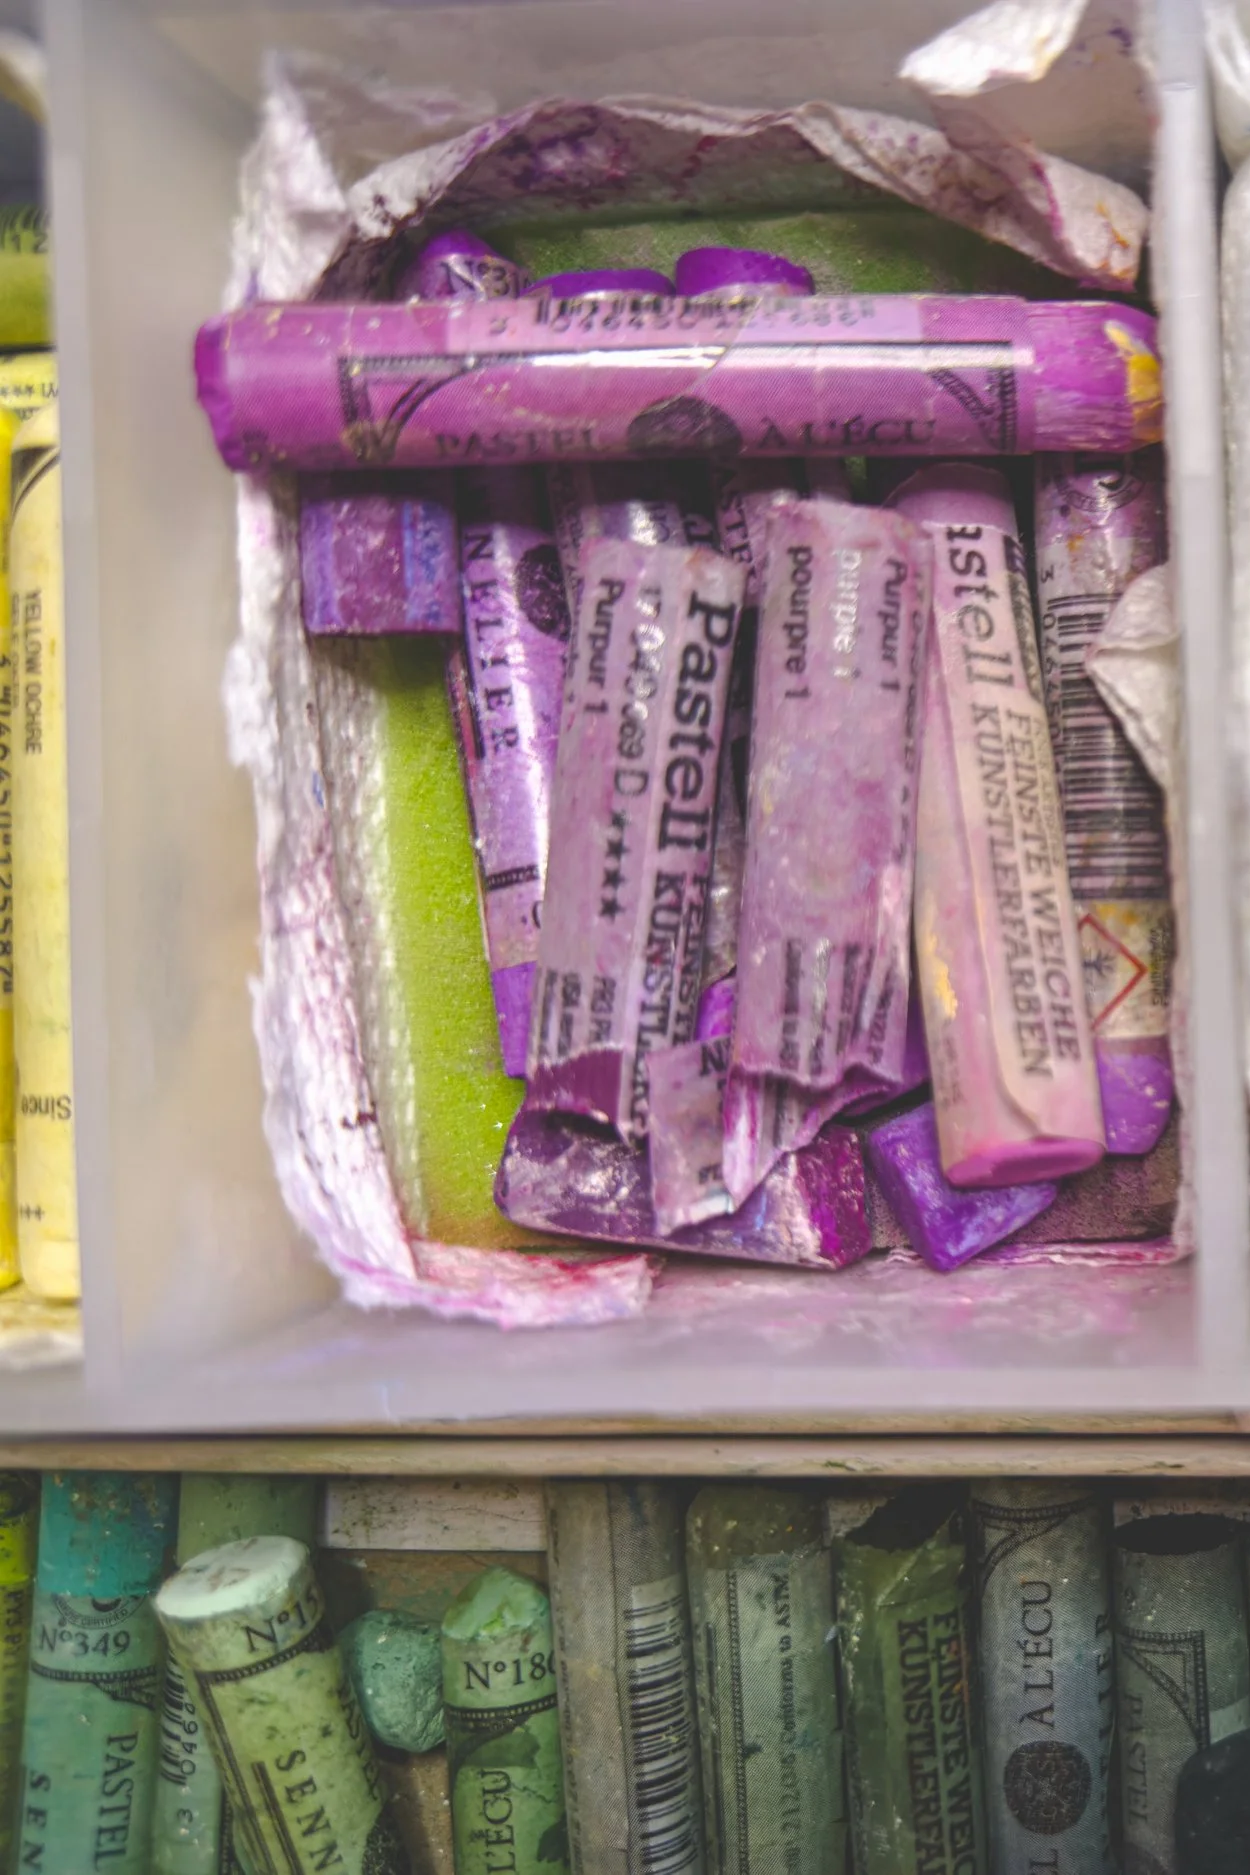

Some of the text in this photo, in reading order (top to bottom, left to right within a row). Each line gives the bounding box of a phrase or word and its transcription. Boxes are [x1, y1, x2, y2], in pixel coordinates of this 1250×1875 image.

[782, 546, 816, 675] pourpre
[878, 559, 909, 668] Purpur
[1040, 564, 1056, 583] 3
[24, 590, 43, 755] YELLOW OCHRE
[588, 578, 627, 689] Purpur
[656, 590, 738, 854] Pastell
[1006, 709, 1059, 876] FEINSTE
[1033, 888, 1081, 1062] WEICHE
[20, 1094, 72, 1122] Since
[932, 1608, 969, 1775] FEINSTE
[1016, 1577, 1056, 1692] L'ÉCU
[20, 1769, 51, 1873] SEN
[94, 1730, 140, 1871] PASTEL
[175, 1807, 195, 1824] 3
